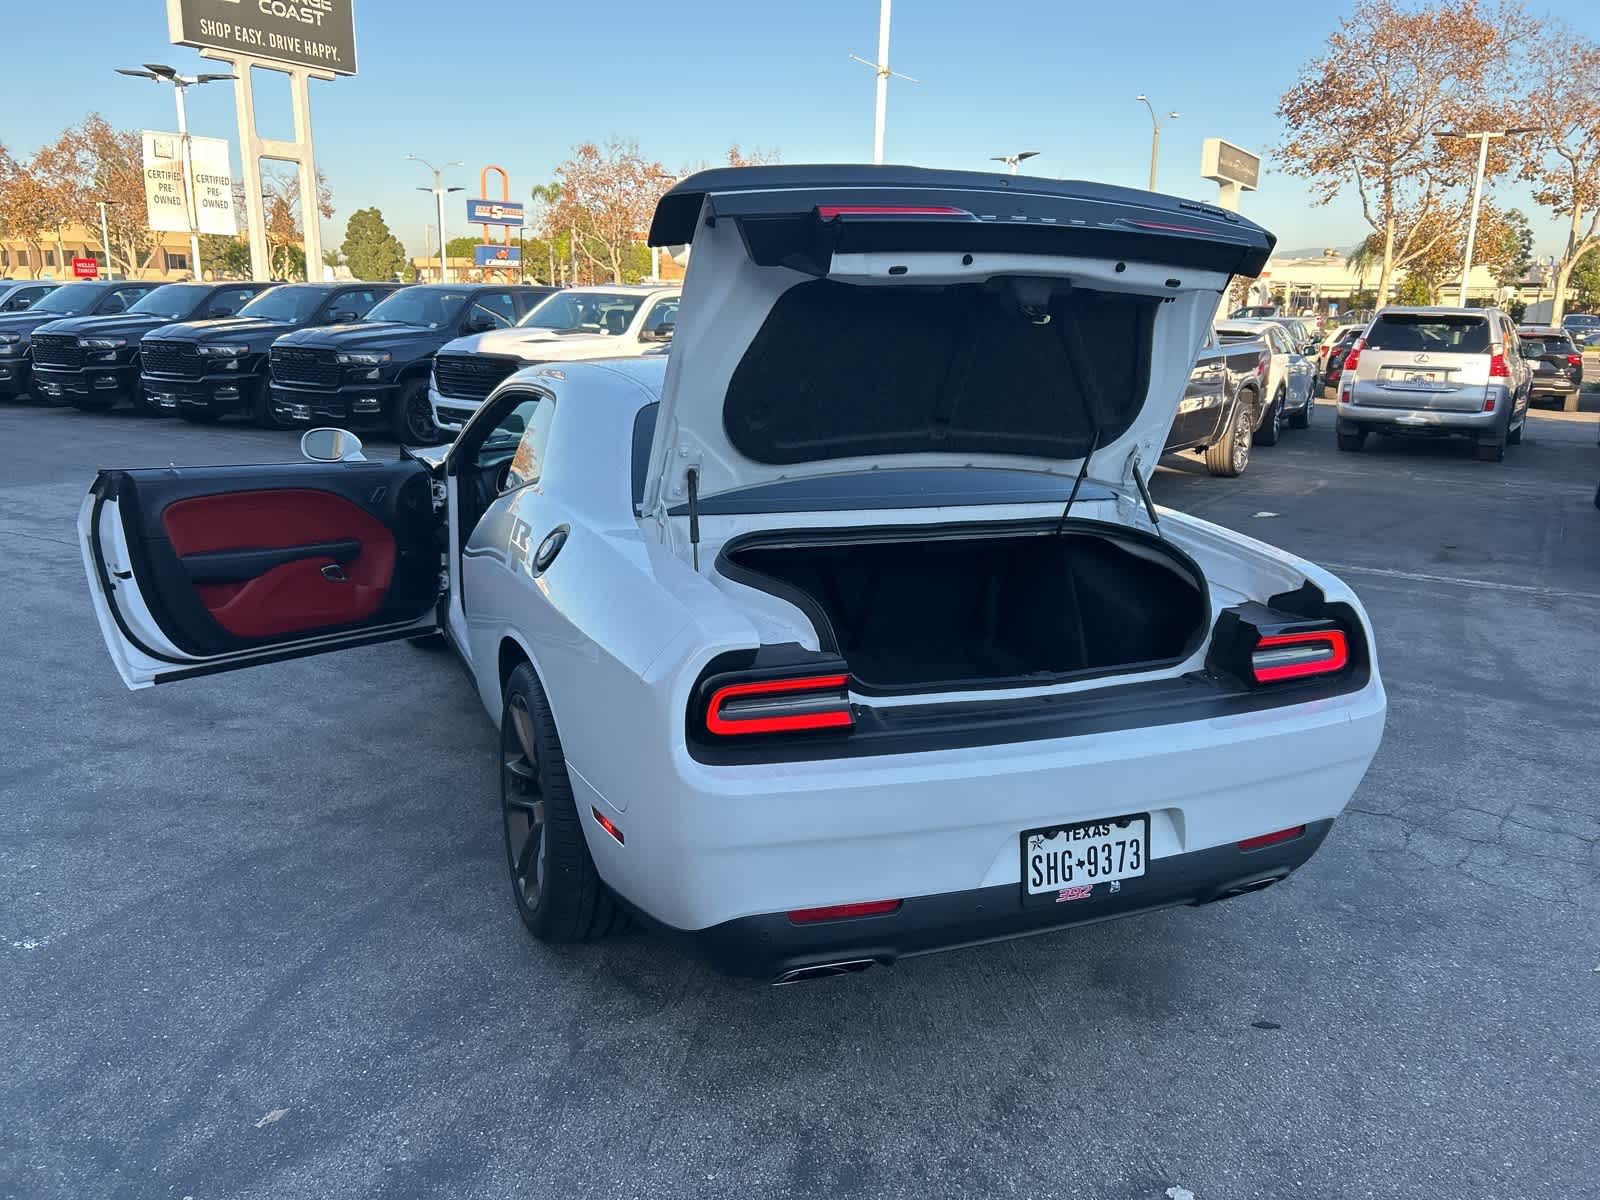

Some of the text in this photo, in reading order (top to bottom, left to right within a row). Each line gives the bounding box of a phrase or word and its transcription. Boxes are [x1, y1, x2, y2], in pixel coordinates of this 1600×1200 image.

[259, 0, 324, 26] COAST
[200, 18, 341, 62] SHOP EASY. DRIVE HAPPY.
[147, 169, 181, 181] CERTIFIED
[195, 174, 230, 186] CERTIFIED
[158, 182, 175, 193] PRE-
[207, 187, 222, 197] PRE-
[154, 194, 181, 206] OWNED
[202, 198, 229, 210] OWNED
[1063, 823, 1111, 842] TEXAS
[1031, 838, 1141, 888] SHG 9373
